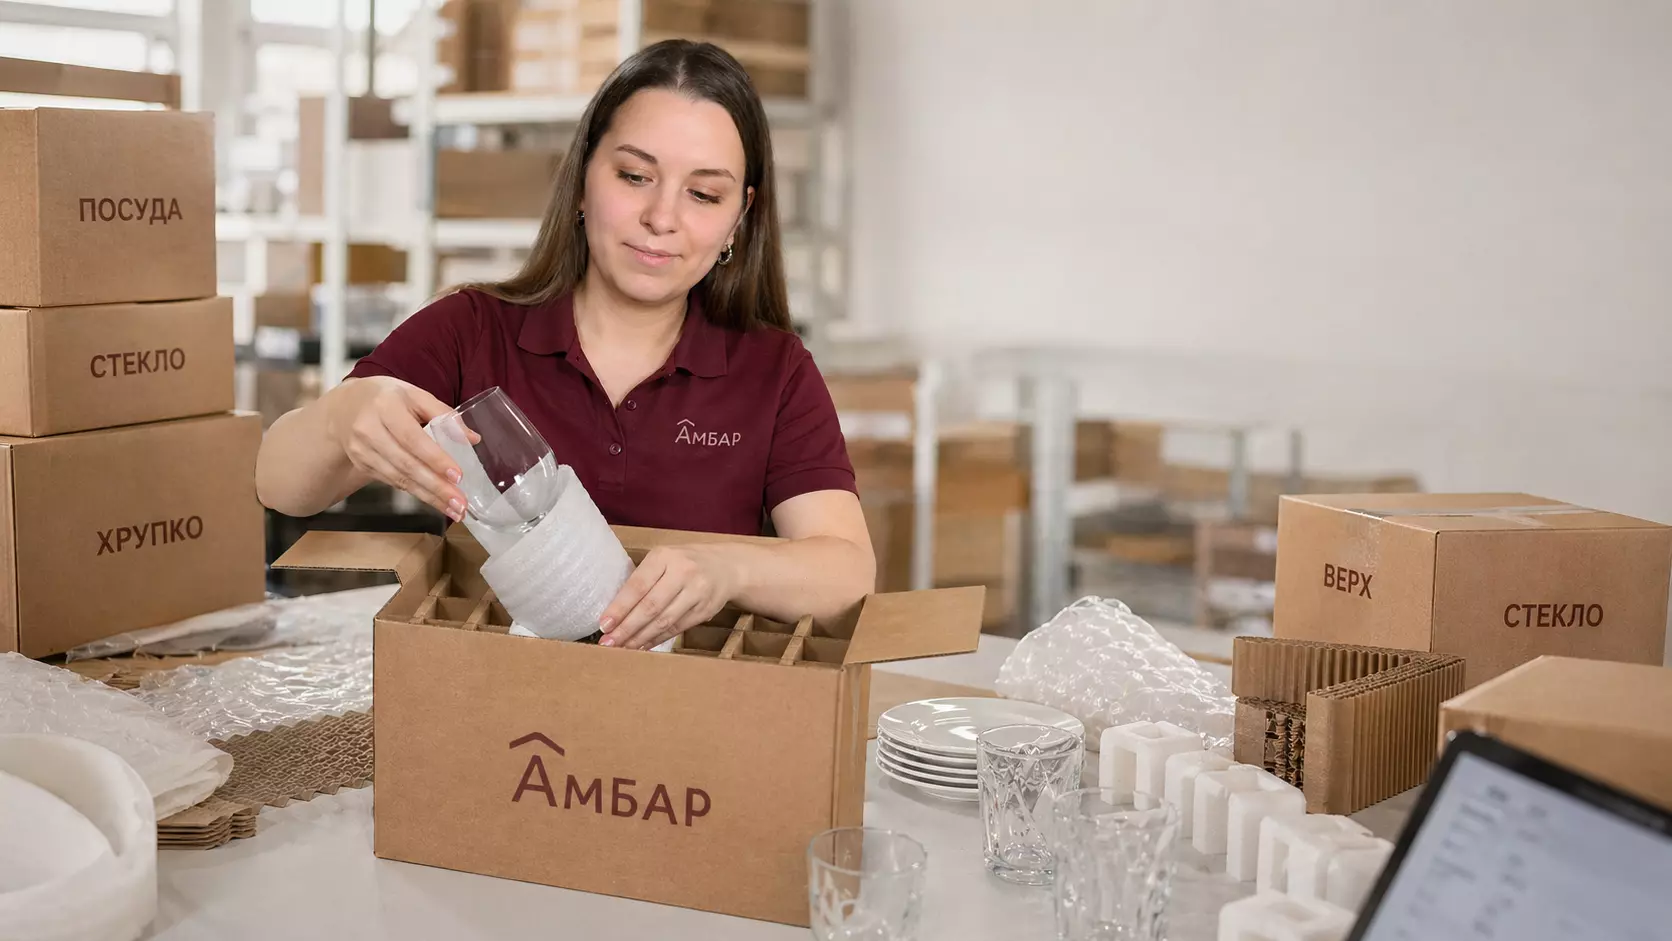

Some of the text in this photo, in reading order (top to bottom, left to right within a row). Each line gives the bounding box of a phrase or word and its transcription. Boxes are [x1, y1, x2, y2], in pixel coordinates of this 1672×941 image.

[79, 197, 183, 225] ПОСУДА
[90, 348, 185, 378] СТЕКЛО
[96, 515, 203, 556] ХРУПКО
[1323, 563, 1373, 600] ВЕРХ
[1504, 603, 1604, 628] СТЕКЛО
